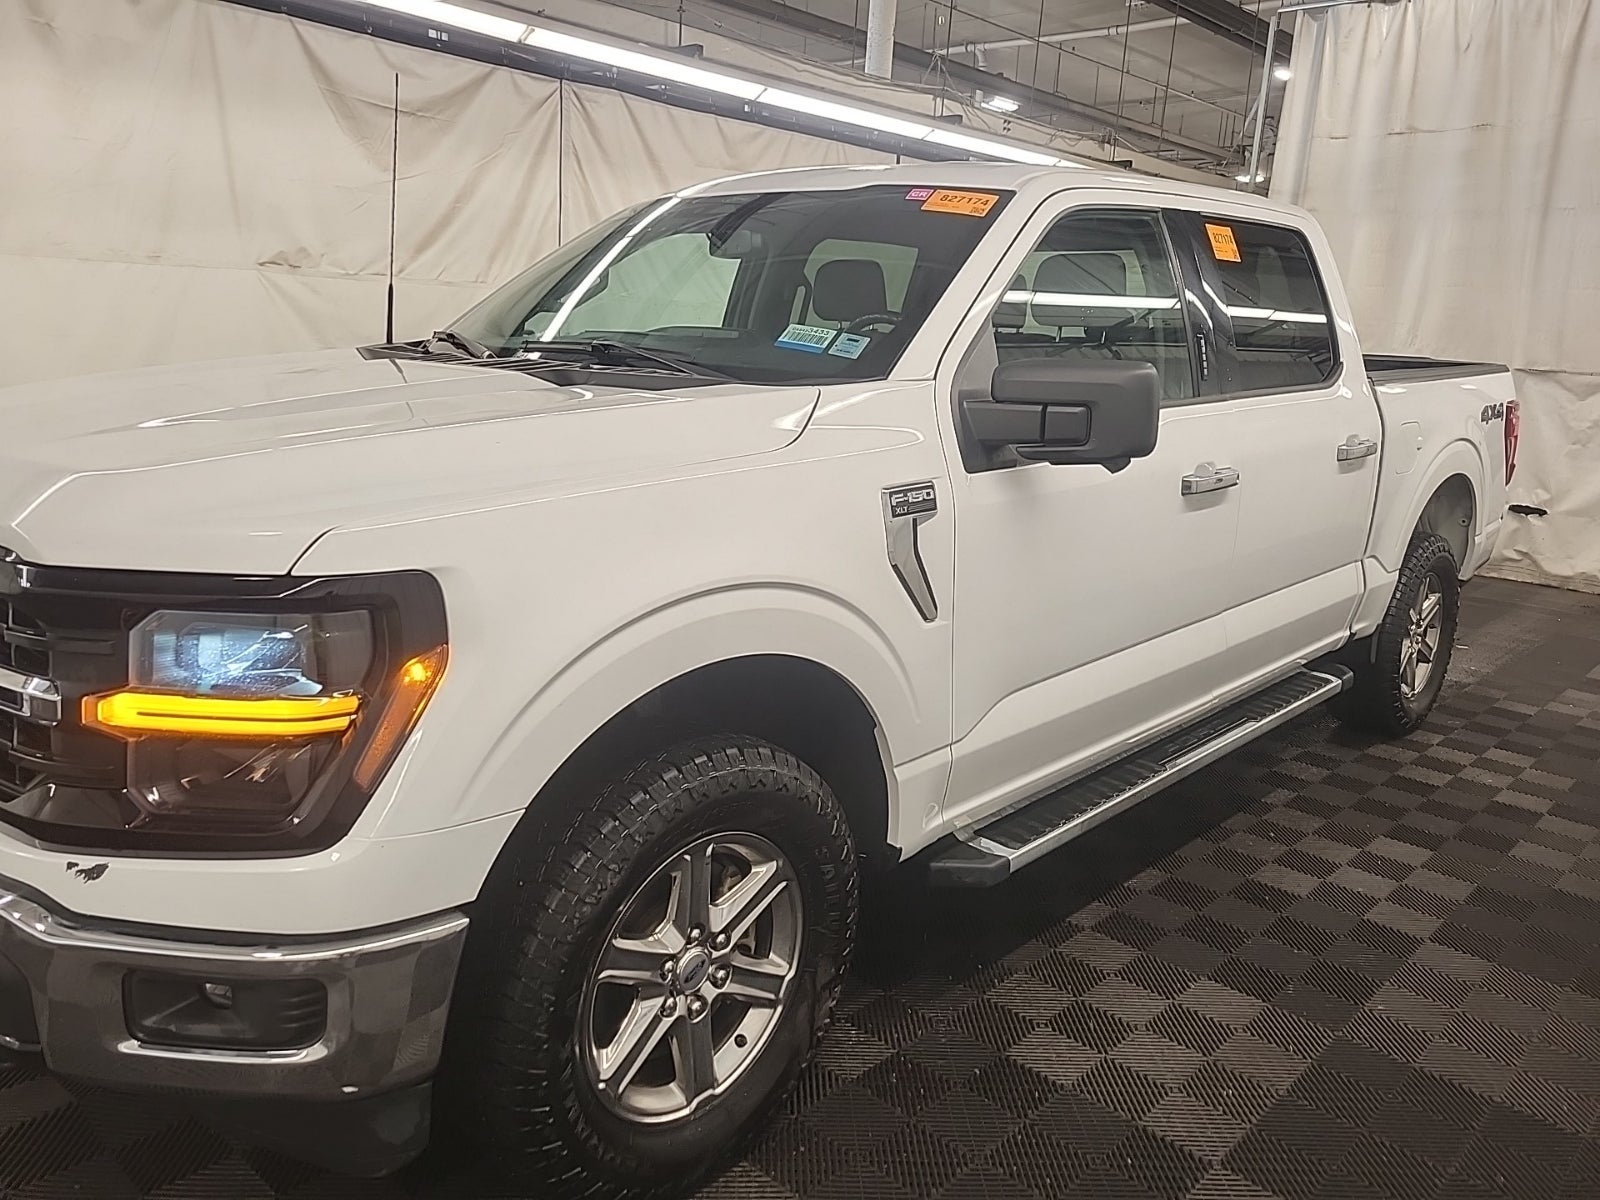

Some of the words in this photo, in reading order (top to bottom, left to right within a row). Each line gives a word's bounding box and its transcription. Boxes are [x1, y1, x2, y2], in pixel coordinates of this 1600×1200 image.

[911, 190, 927, 198] CR
[940, 194, 990, 206] 827174
[891, 489, 934, 506] F-150
[896, 506, 908, 515] XLT
